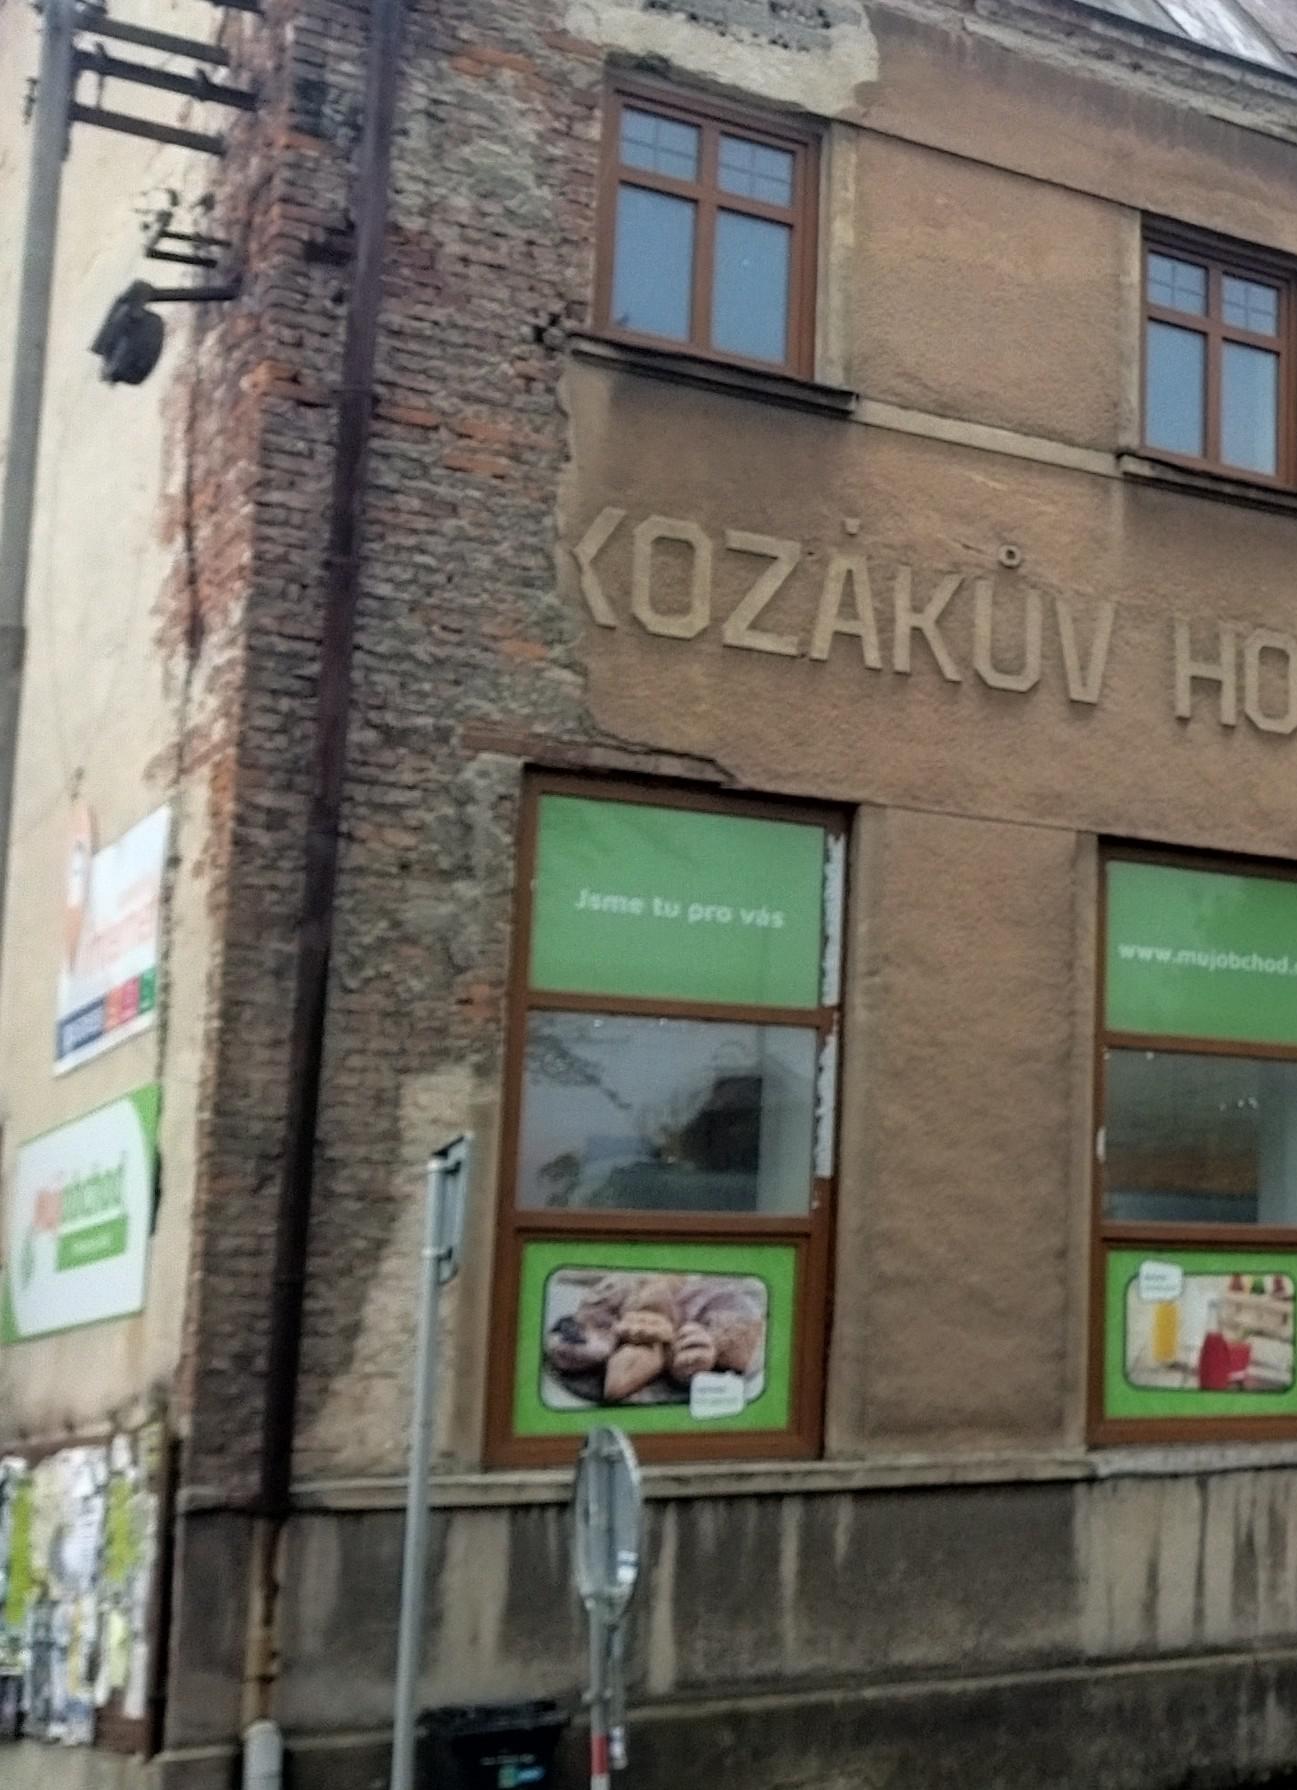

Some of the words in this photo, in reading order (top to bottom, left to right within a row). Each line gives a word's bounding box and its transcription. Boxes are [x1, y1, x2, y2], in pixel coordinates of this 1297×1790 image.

[576, 889, 643, 915] Jsme
[652, 897, 682, 918] tu
[688, 902, 733, 924] pro
